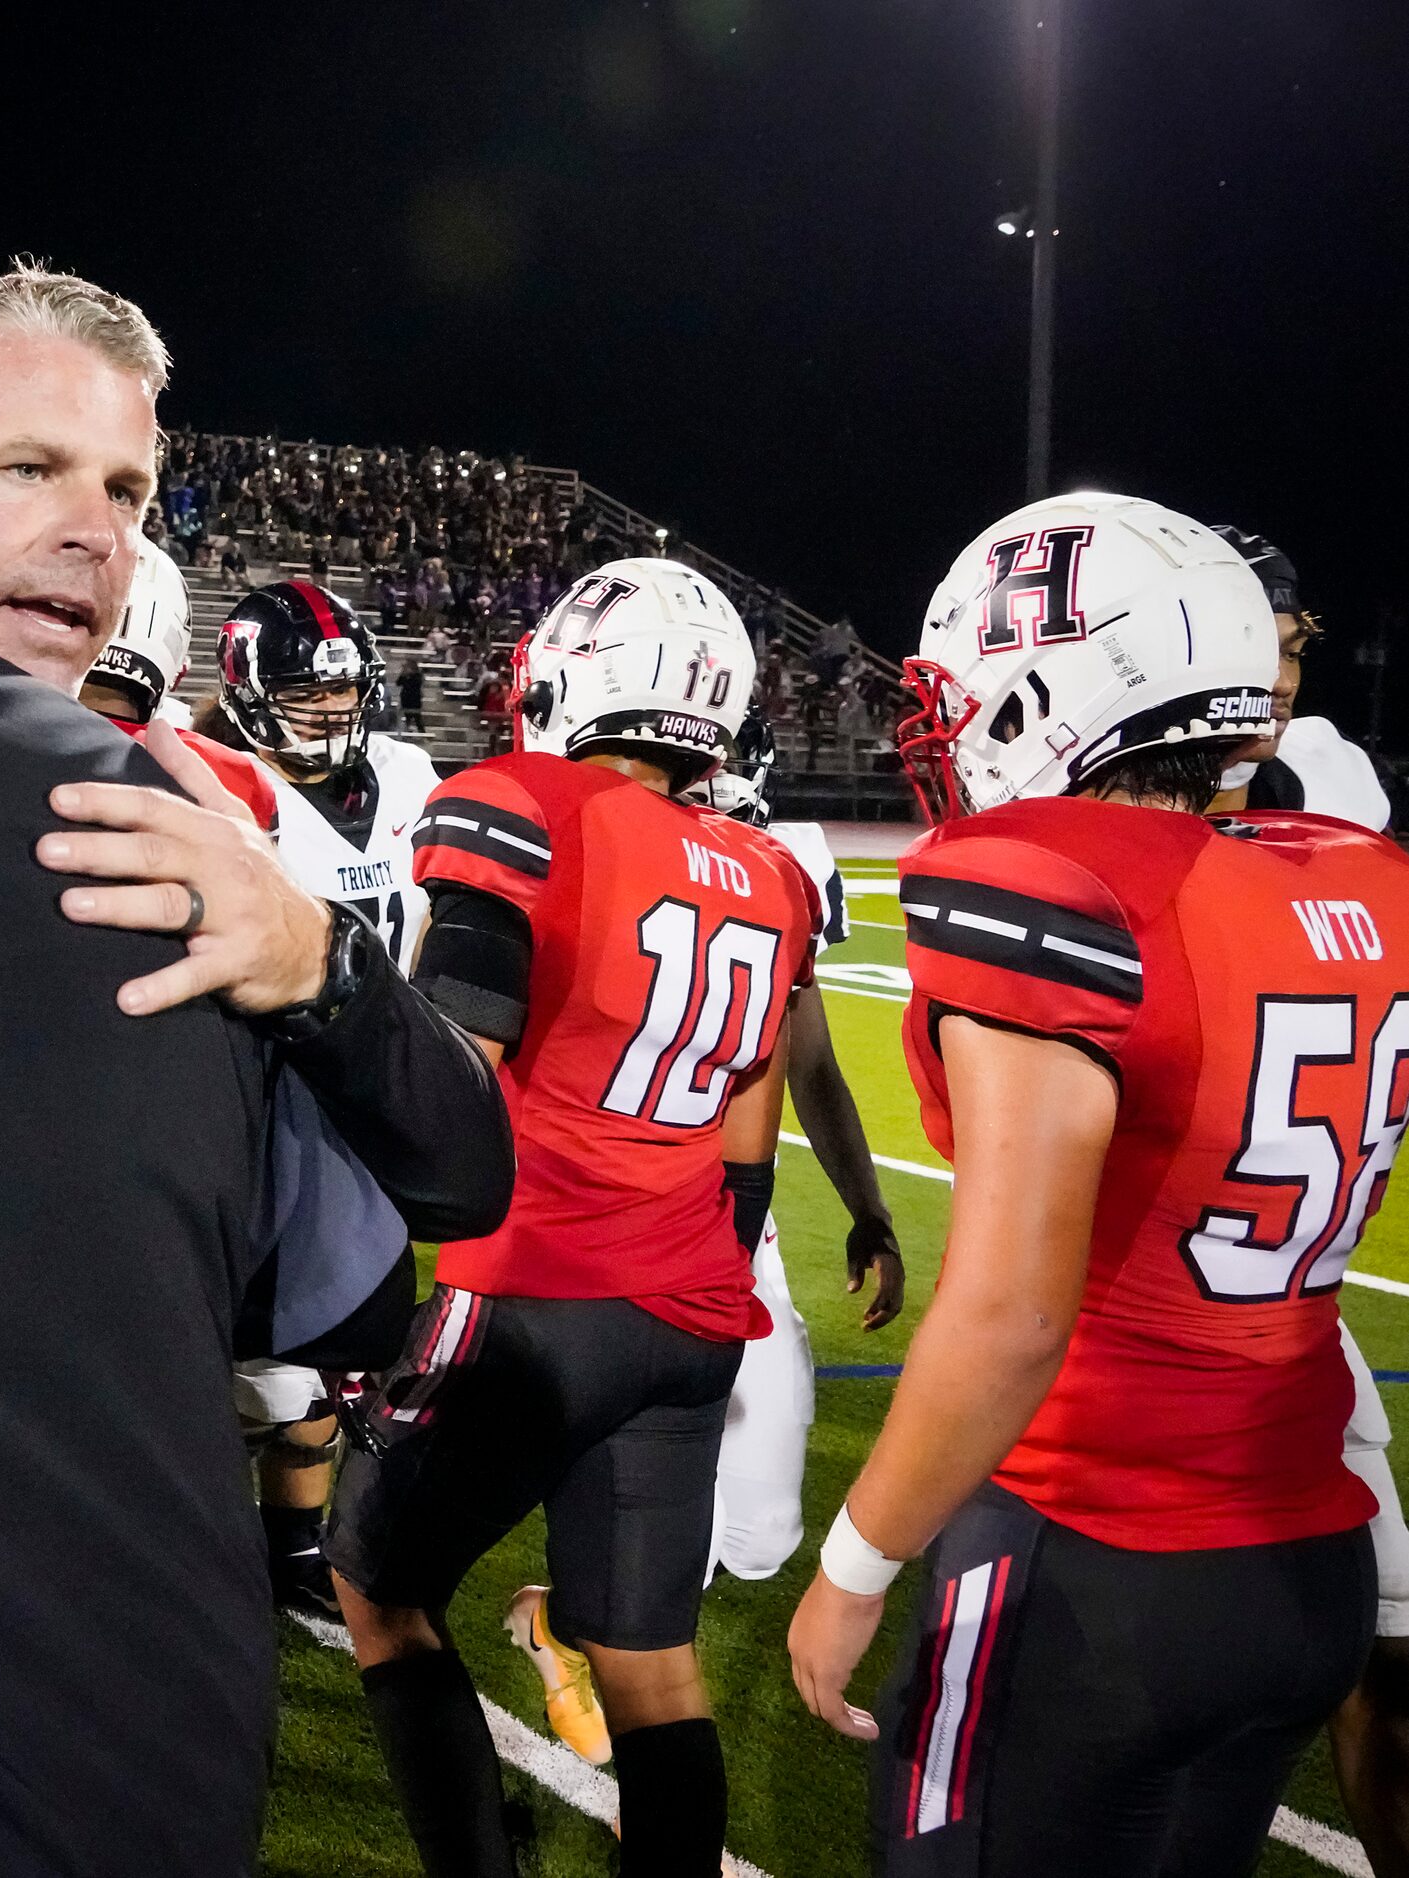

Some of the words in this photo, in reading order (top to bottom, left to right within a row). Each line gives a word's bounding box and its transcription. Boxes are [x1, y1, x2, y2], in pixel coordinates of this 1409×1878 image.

[543, 575, 640, 659] H
[977, 525, 1095, 656] H
[99, 648, 132, 669] WKS
[683, 658, 732, 709] 10
[660, 715, 719, 743] HAWKS
[337, 860, 393, 891] TRINITY
[682, 837, 750, 898] WTD
[1291, 900, 1383, 961] WTD
[598, 894, 782, 1128] 10
